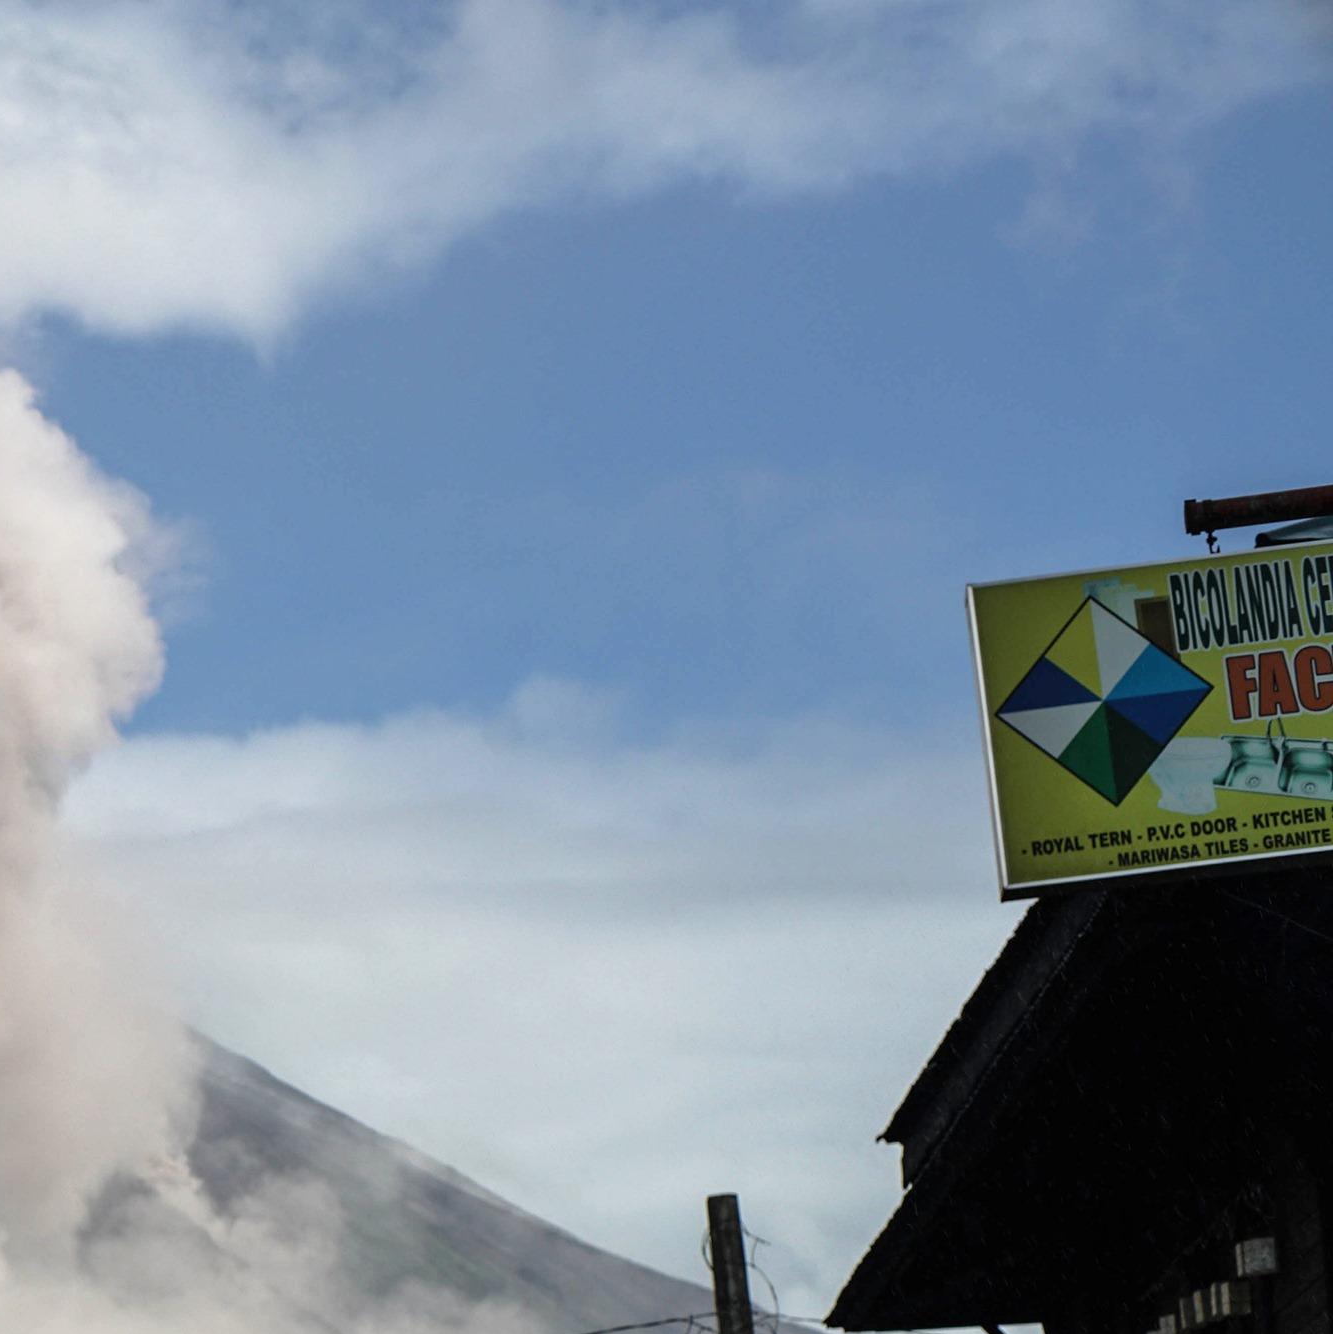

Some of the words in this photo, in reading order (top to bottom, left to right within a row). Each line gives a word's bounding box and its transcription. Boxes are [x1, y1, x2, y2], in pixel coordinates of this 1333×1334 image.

[1169, 560, 1304, 651] BICOLANDIA
[1031, 834, 1085, 857] ROYAL
[1088, 829, 1132, 849] TERN
[1147, 823, 1186, 842] P.V.C
[1190, 817, 1238, 838] DOOR
[1252, 806, 1327, 830] KITCHEN
[1117, 844, 1202, 868] MARIWASA
[1205, 837, 1249, 855] TILES
[1262, 827, 1331, 851] GRANITE
